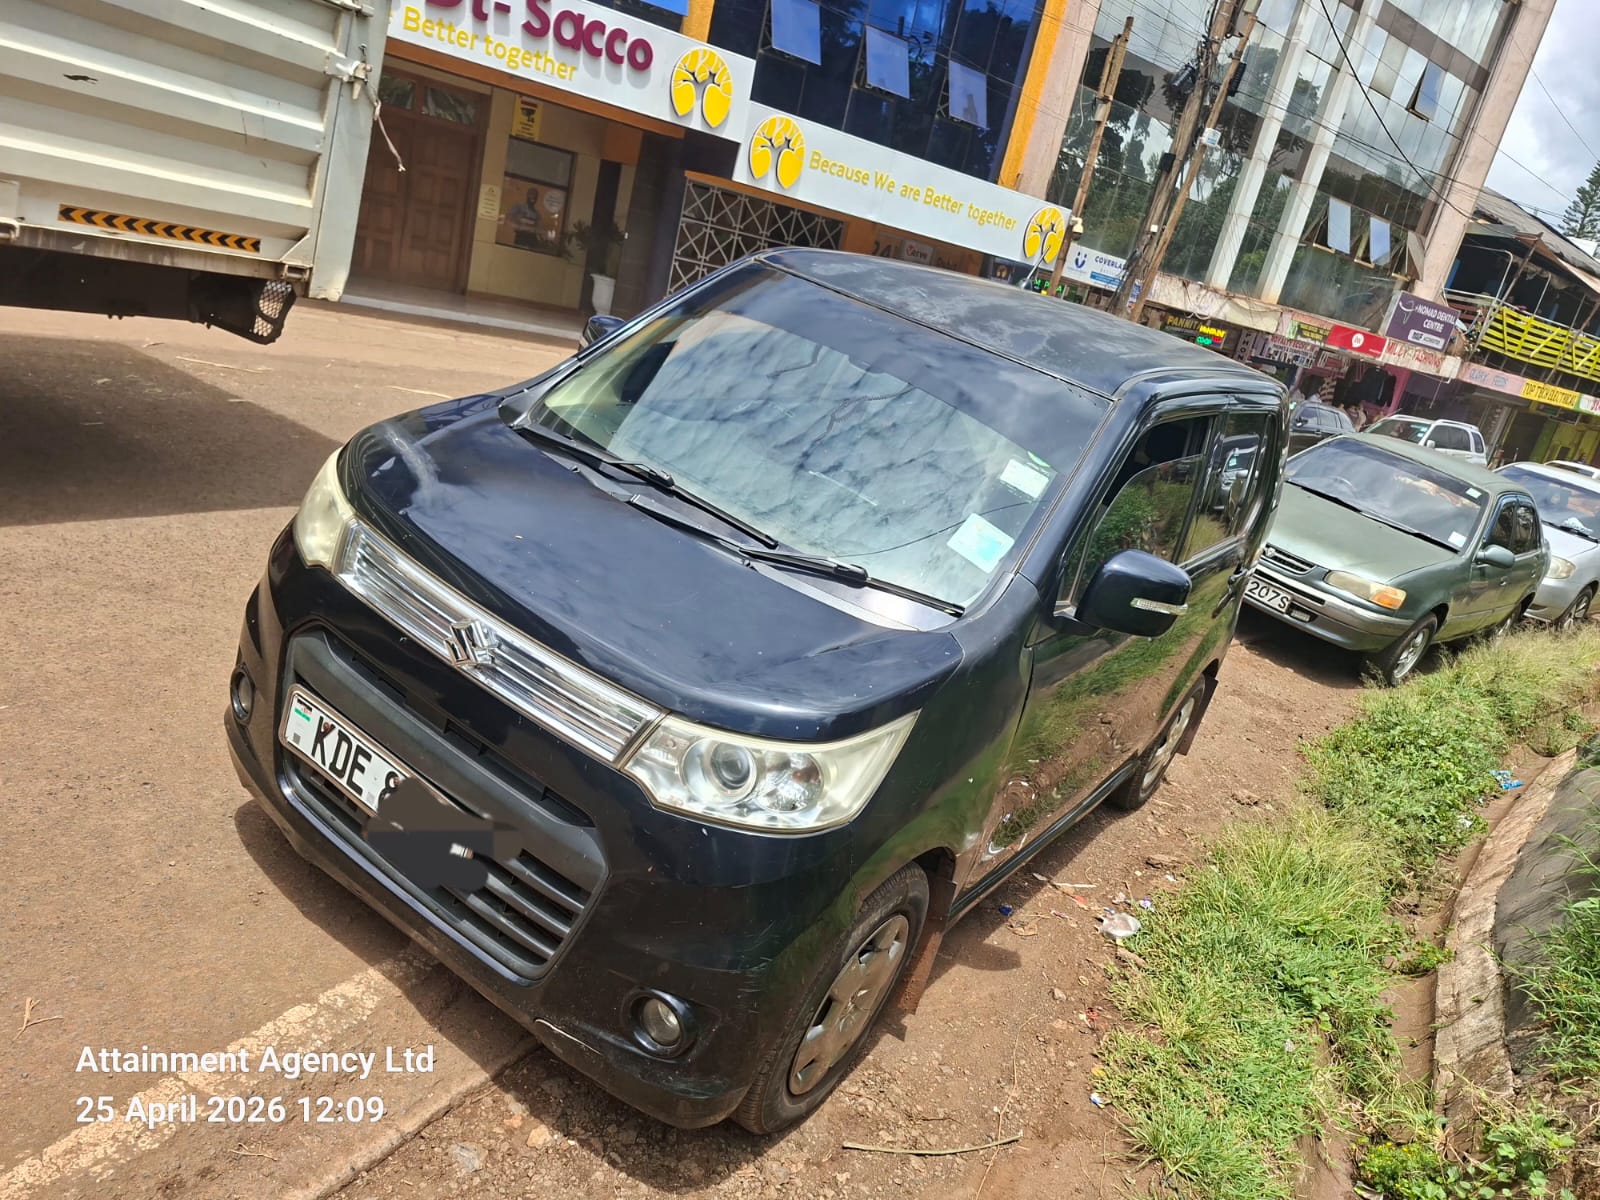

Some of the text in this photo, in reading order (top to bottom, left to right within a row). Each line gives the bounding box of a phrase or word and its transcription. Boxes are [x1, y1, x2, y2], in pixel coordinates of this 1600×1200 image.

[403, 6, 577, 81] Better together
[521, 0, 653, 72] Sacco
[809, 149, 1017, 231] Because We are Better together
[1422, 318, 1444, 332] CENTRE
[1436, 310, 1456, 324] DENTAL
[1522, 382, 1536, 396] TOP
[1248, 581, 1289, 609] 207S
[311, 715, 372, 796] KDE
